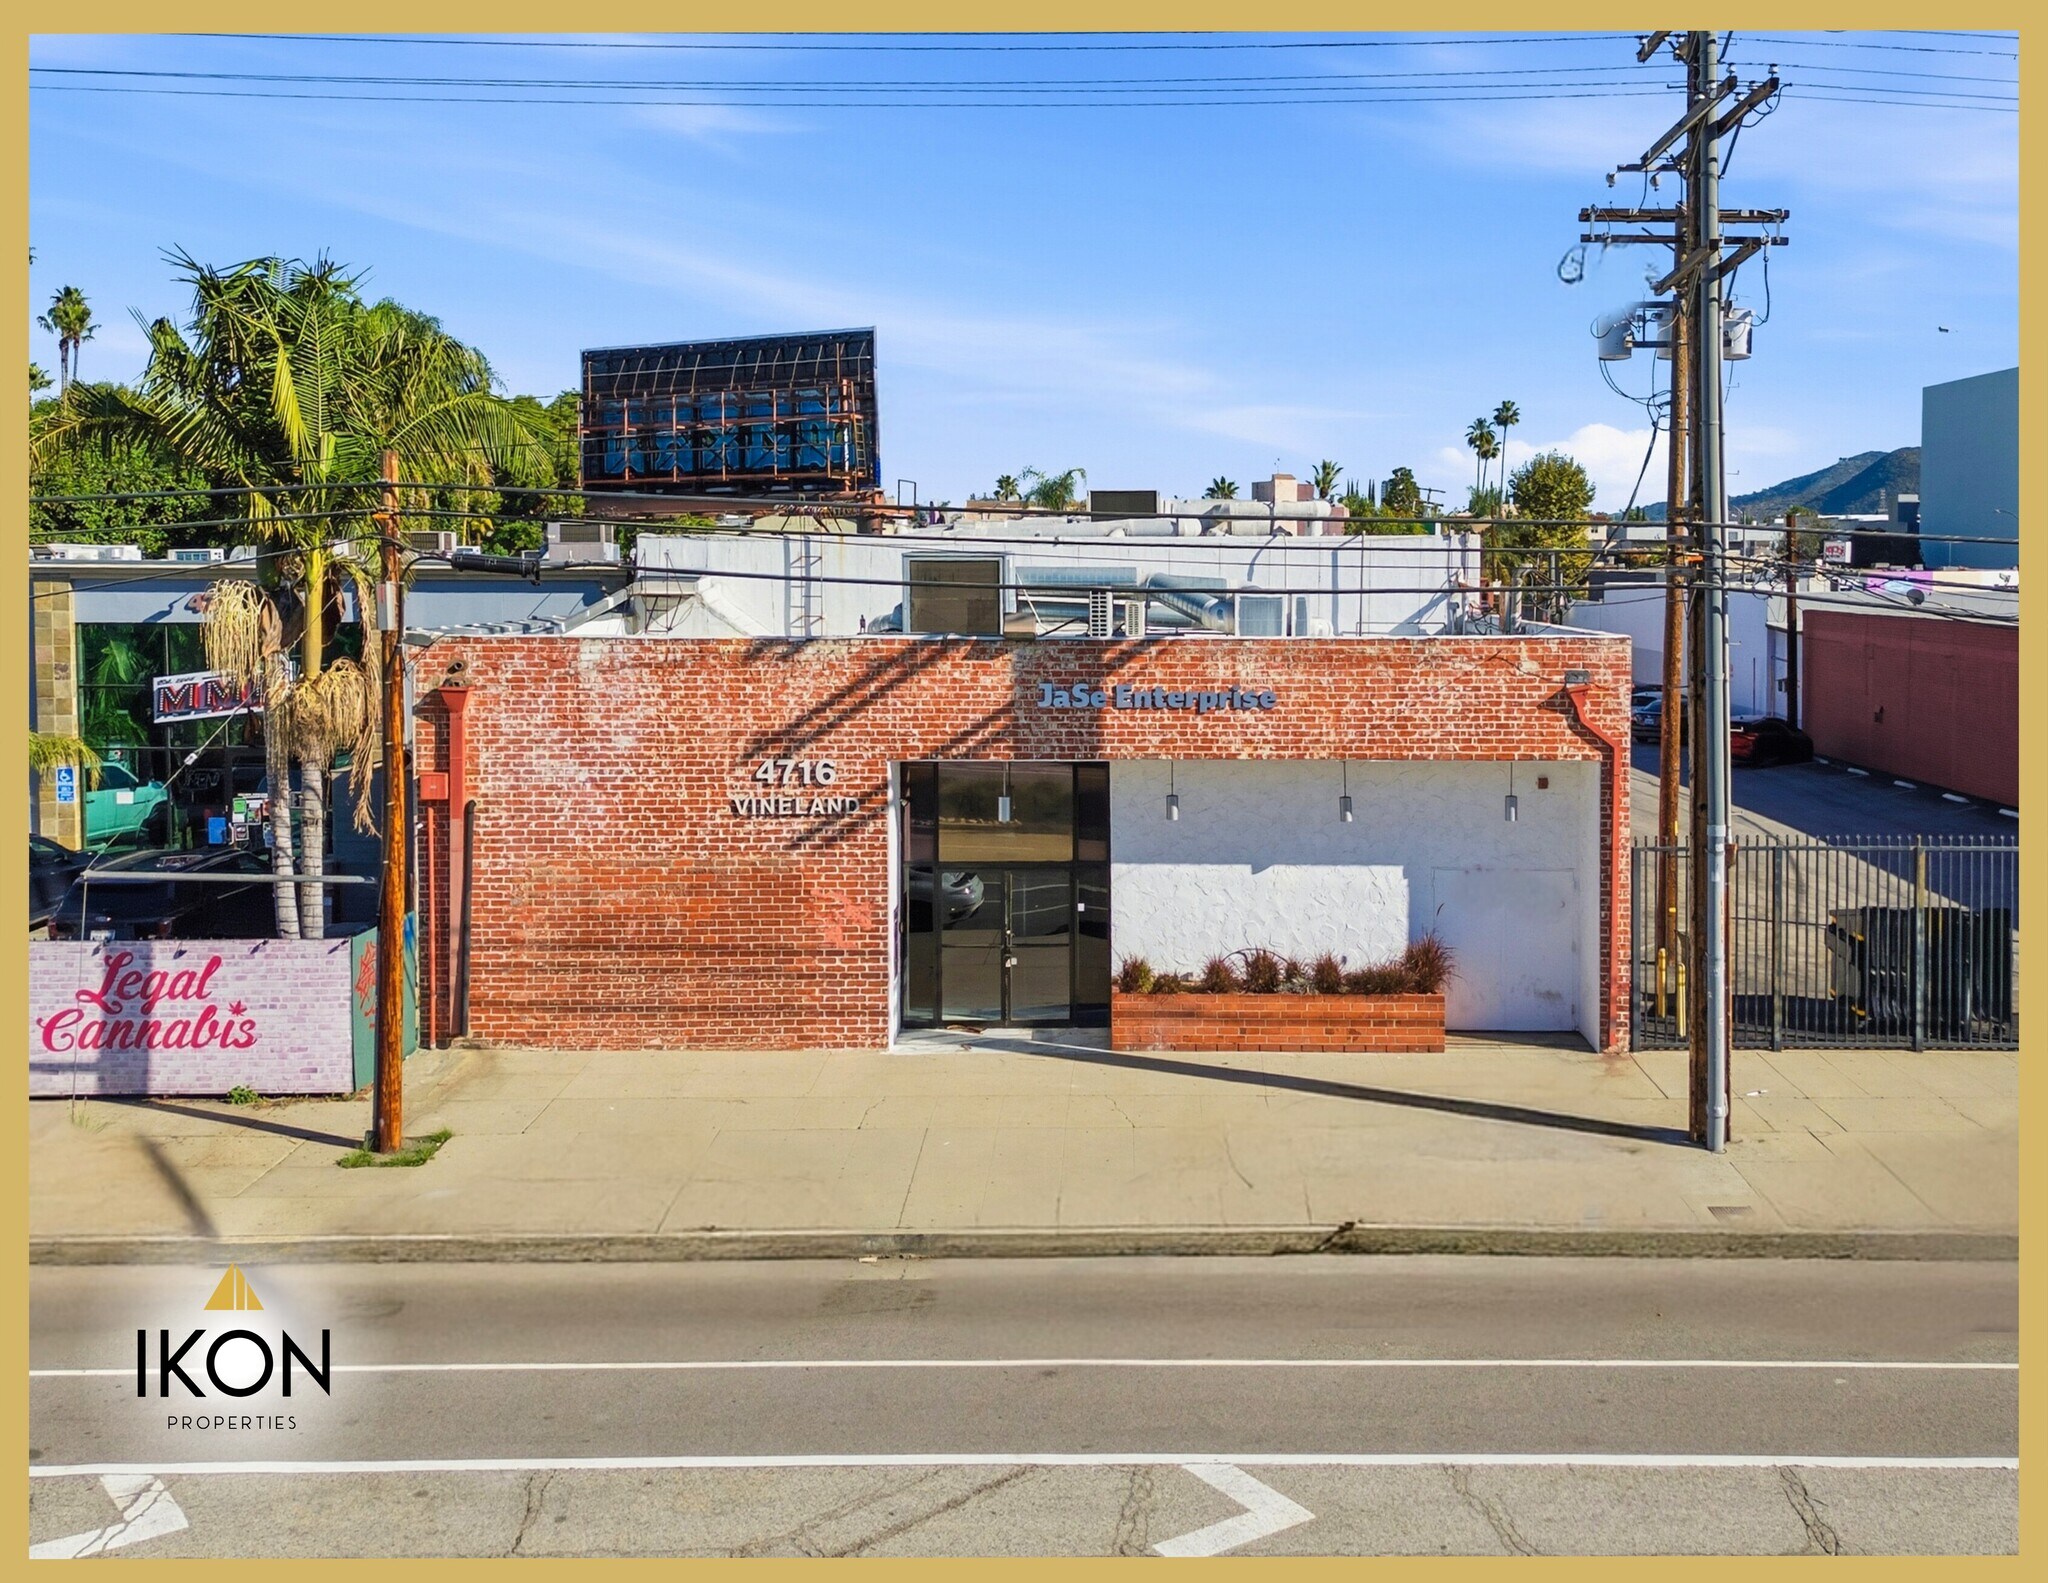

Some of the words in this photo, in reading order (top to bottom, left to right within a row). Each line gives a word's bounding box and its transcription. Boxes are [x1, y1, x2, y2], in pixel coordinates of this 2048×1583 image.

[1037, 682, 1107, 709] JaSe
[1114, 683, 1278, 713] Enterprise
[754, 758, 837, 785] 4716
[733, 797, 861, 815] VINELAND
[75, 951, 222, 1016] Legal
[36, 1000, 258, 1053] Cannabis
